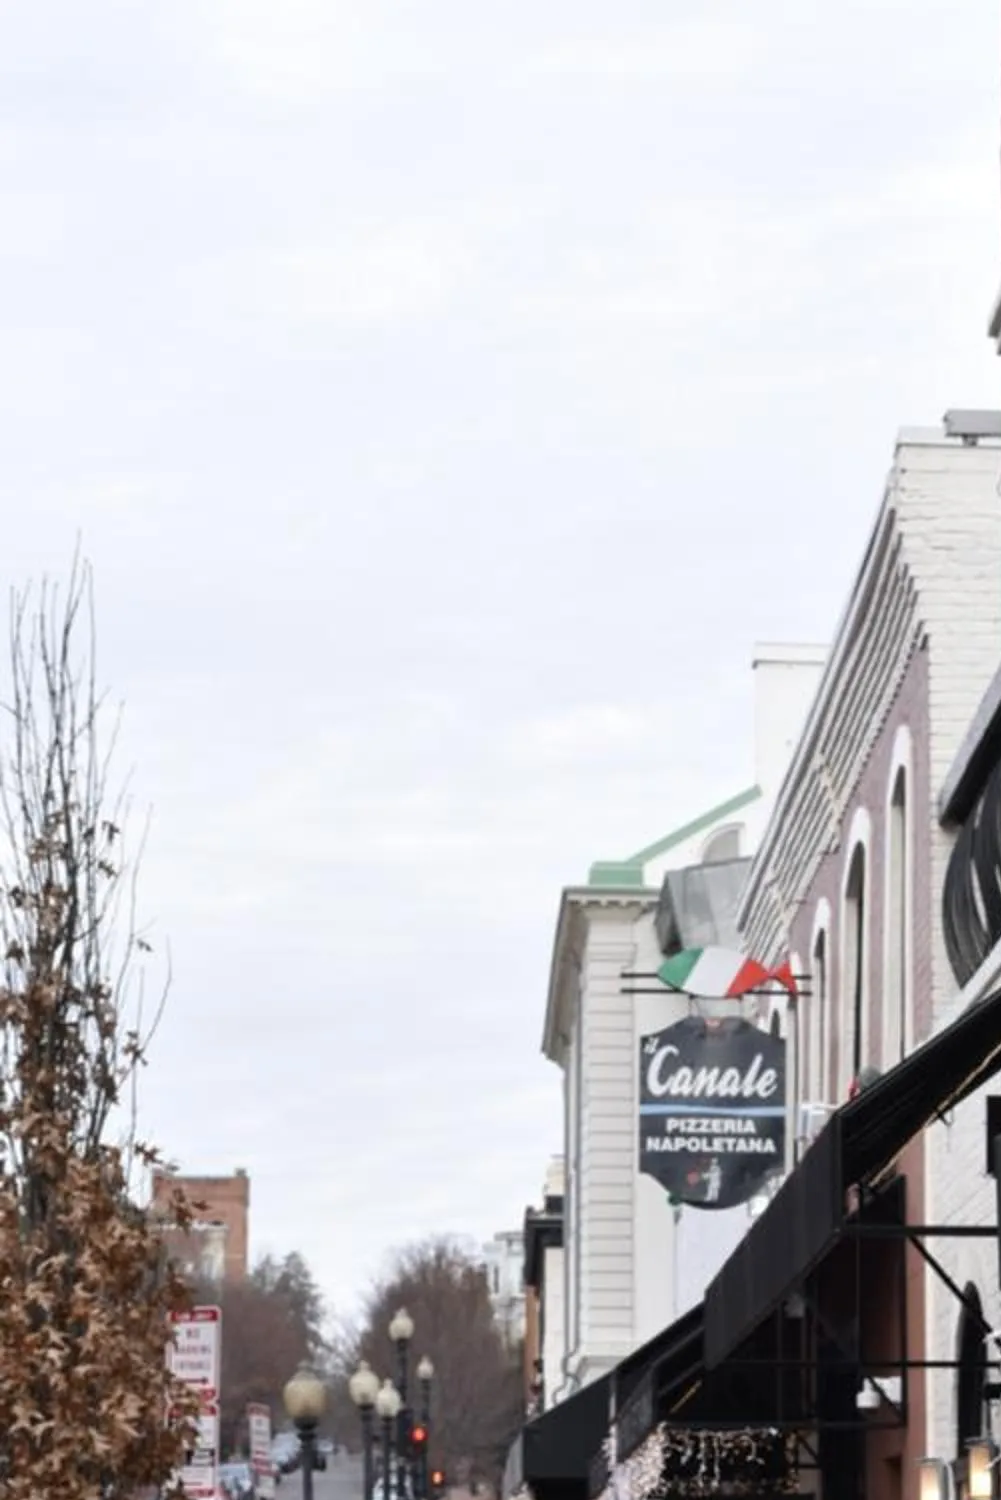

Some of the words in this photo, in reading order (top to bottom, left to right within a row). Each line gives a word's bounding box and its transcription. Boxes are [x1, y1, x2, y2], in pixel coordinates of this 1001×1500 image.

[646, 1045, 778, 1098] Canale
[666, 1117, 757, 1134] PIZZERIA
[645, 1137, 777, 1153] NAPOLETANA
